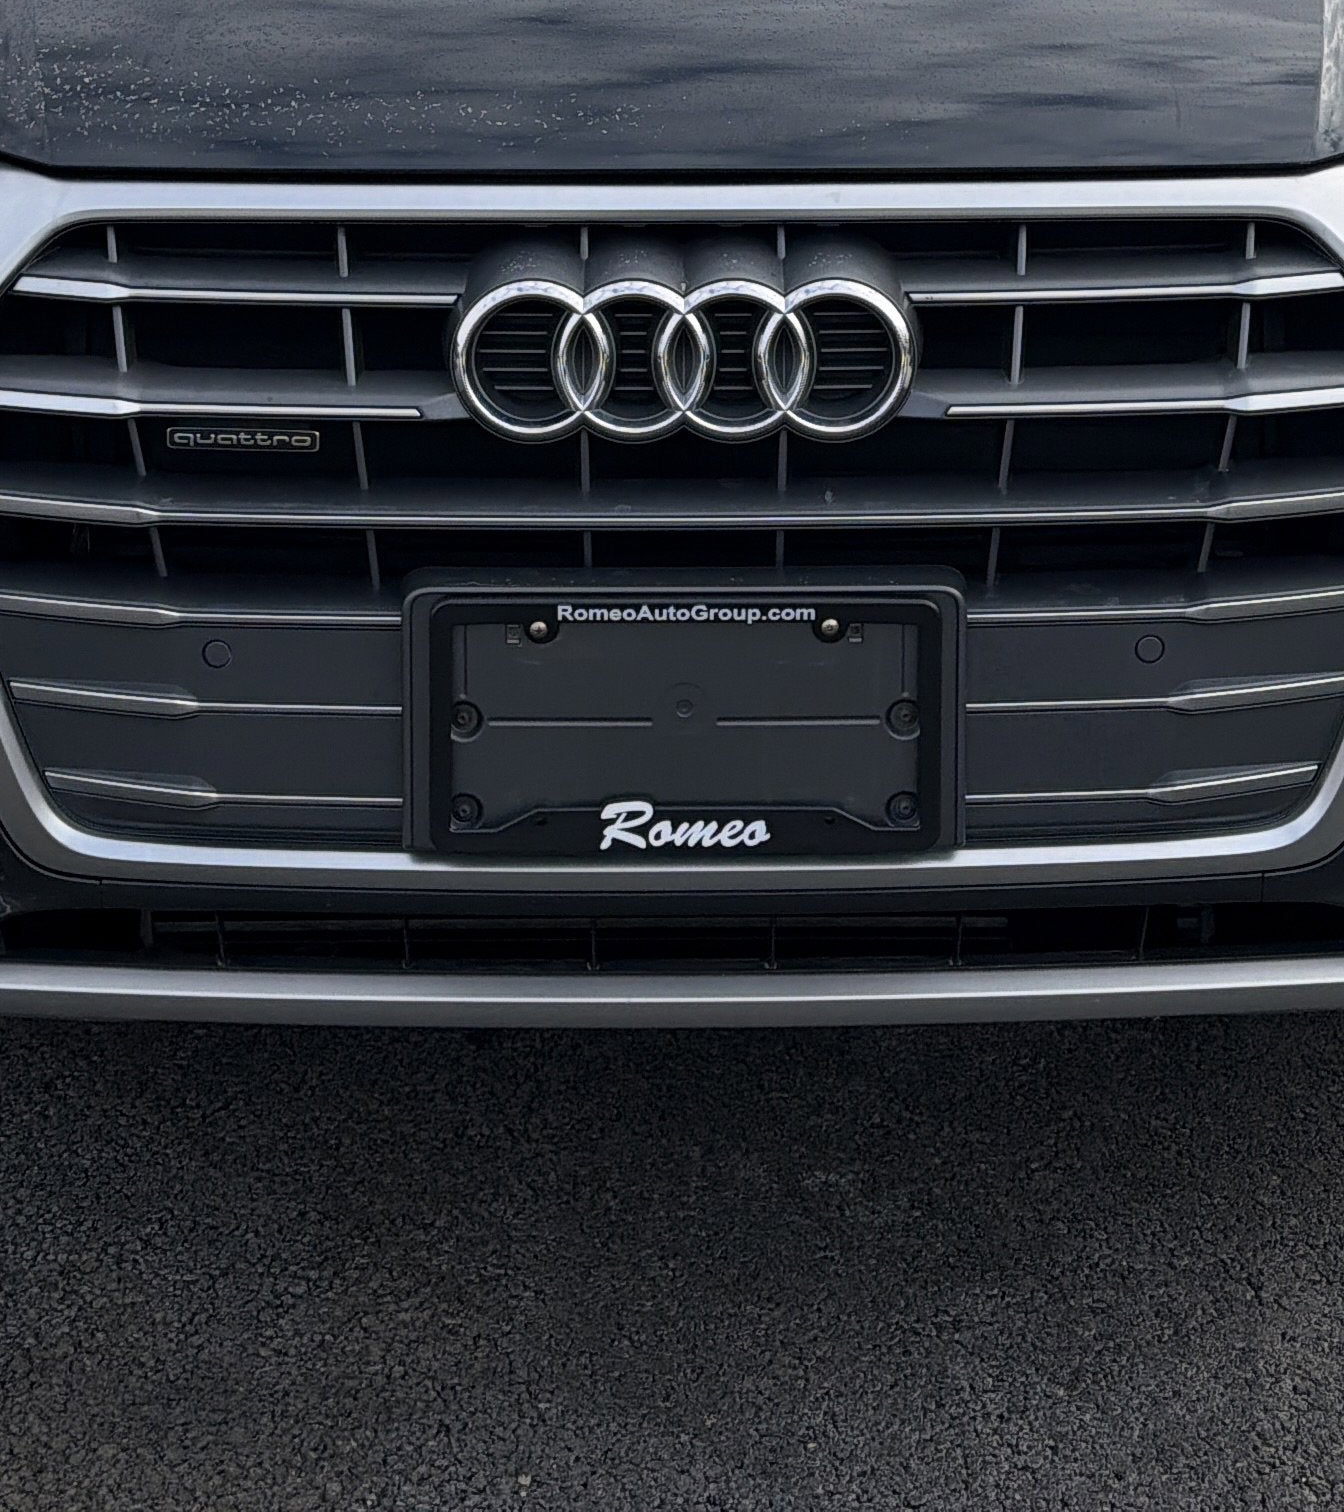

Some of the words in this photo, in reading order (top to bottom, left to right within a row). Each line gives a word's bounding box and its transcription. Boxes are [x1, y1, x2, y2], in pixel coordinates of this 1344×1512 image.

[173, 432, 312, 446] quattro
[557, 604, 815, 624] RomeoAutoGroup.com
[600, 801, 771, 850] Romeo
